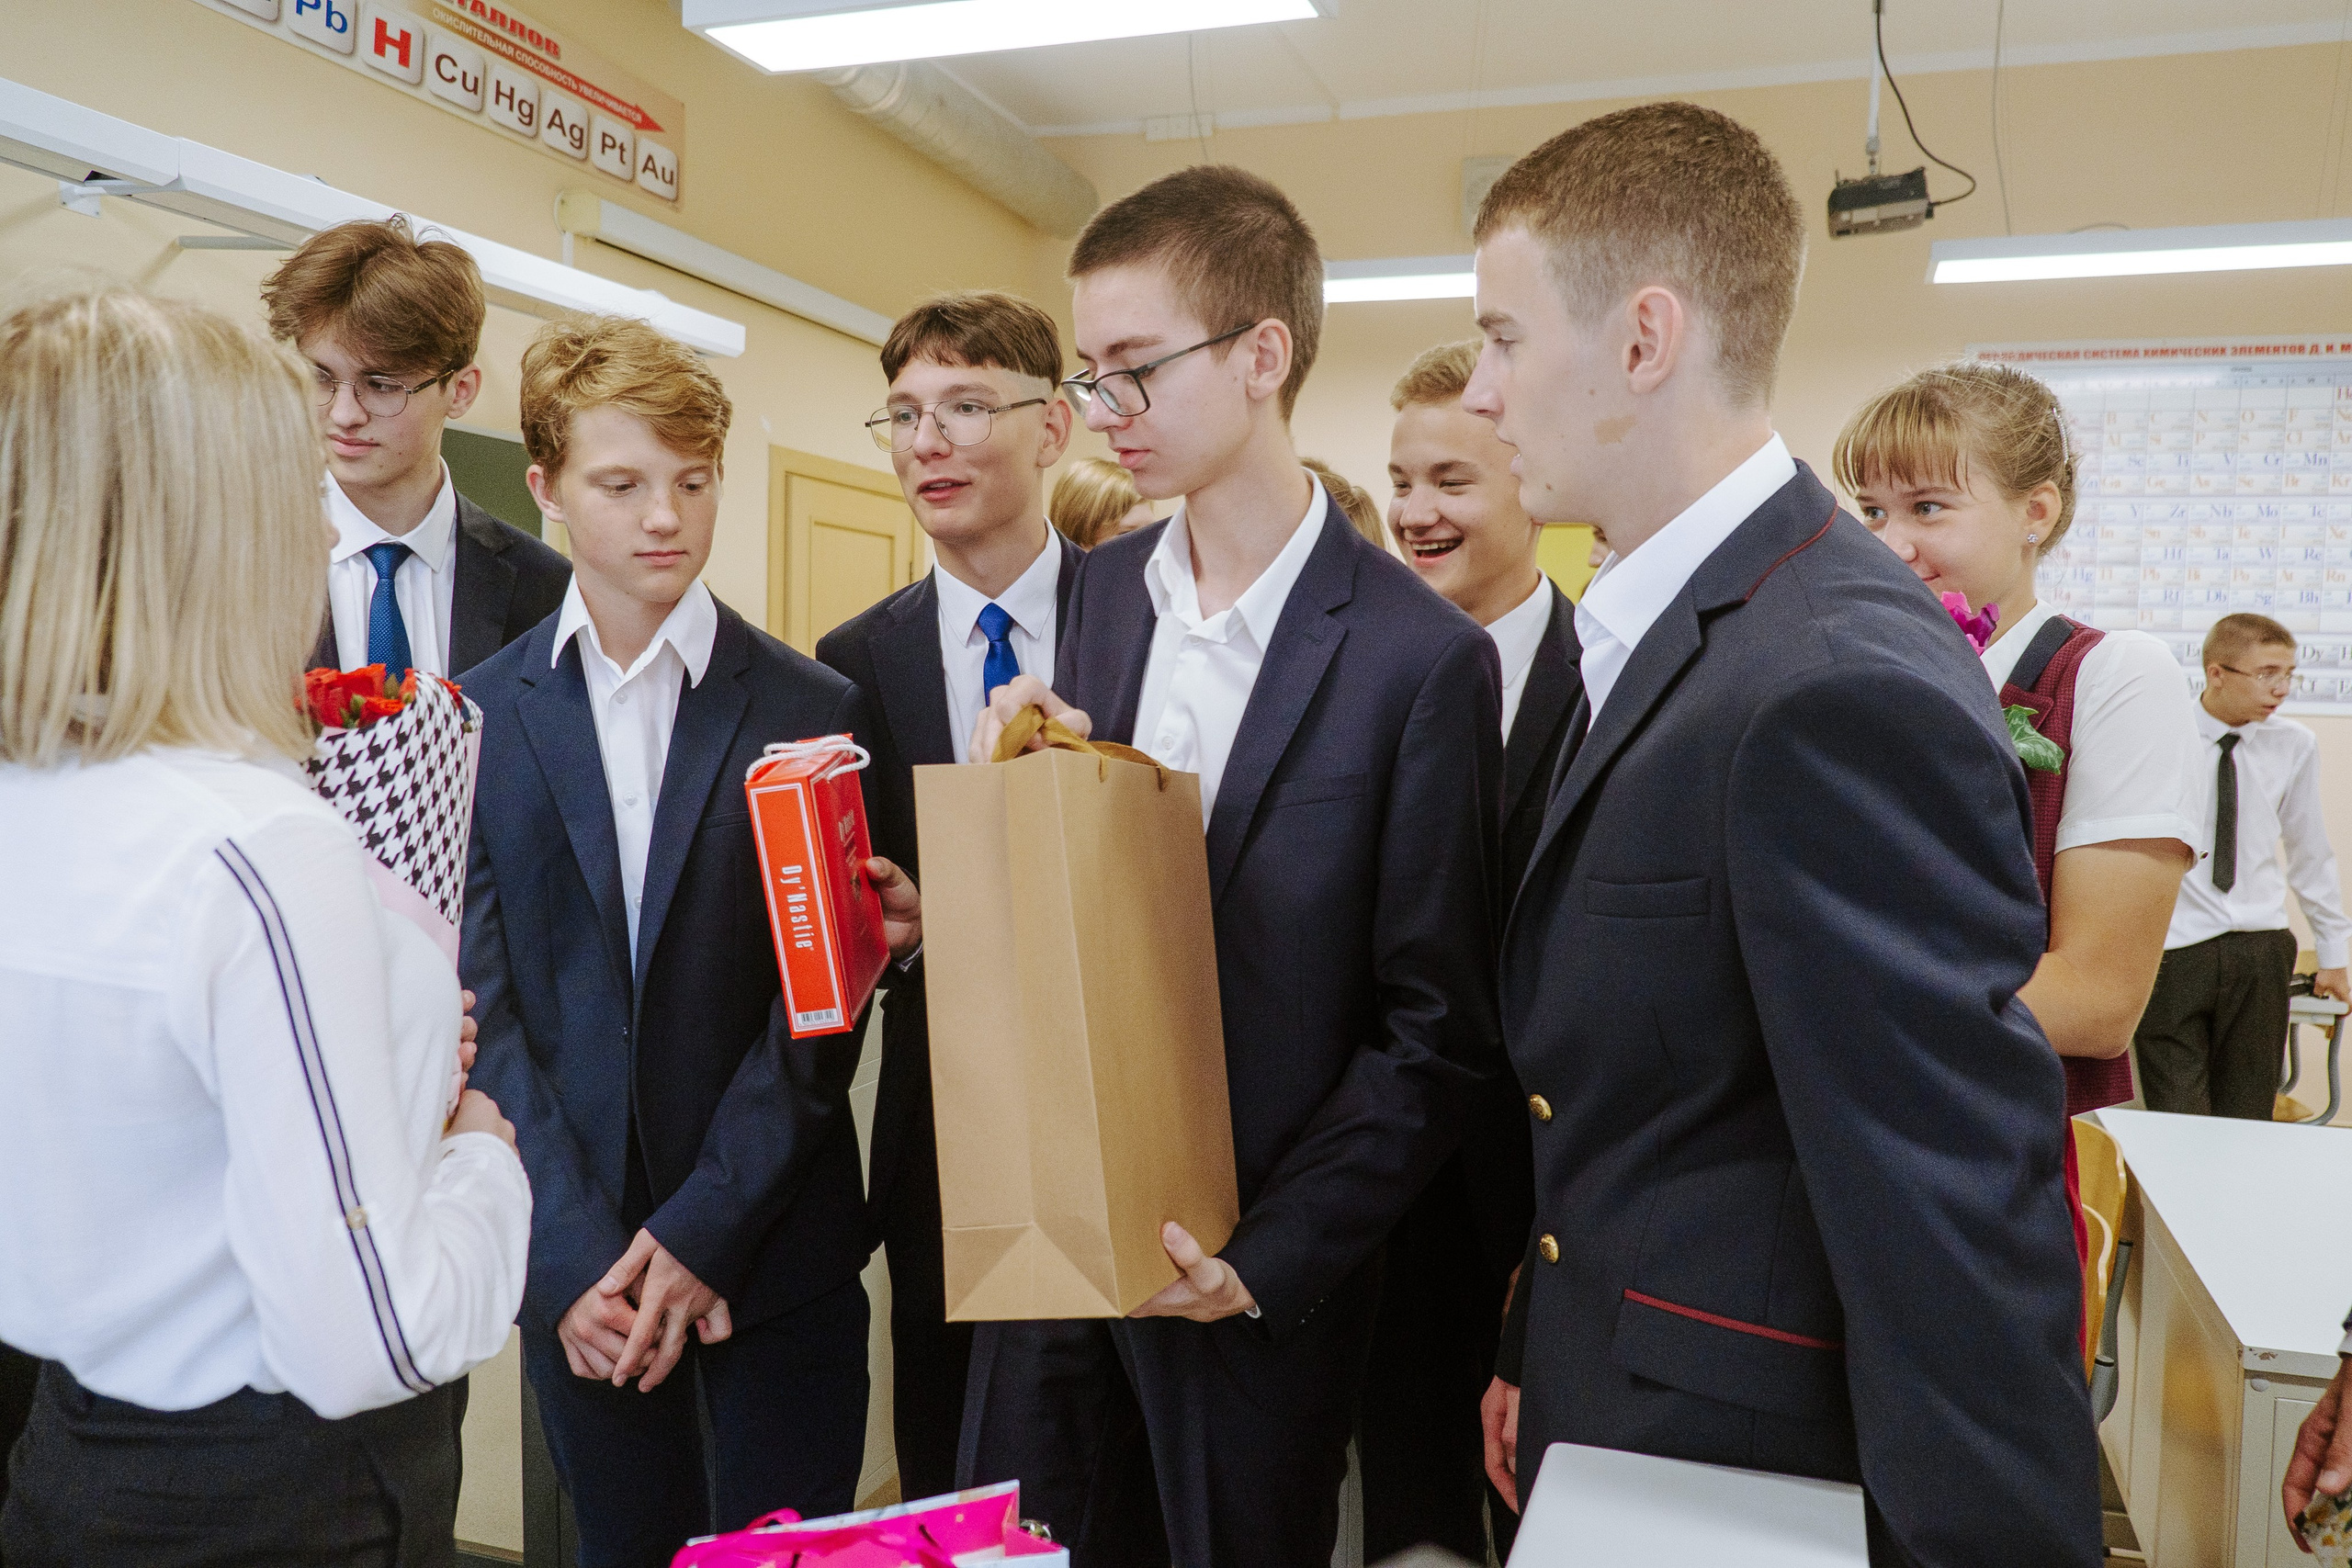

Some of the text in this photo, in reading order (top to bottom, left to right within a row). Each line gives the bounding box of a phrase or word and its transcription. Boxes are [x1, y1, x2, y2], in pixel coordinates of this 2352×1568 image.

[433, 8, 514, 56] ОКИСЛИТЕЛЬНАЯ
[514, 51, 579, 90] СПОСОБНОСТЬ
[445, 0, 560, 58] АЛЛОВ
[373, 17, 412, 69] H
[435, 53, 479, 96] Cu
[494, 79, 534, 127] Hg
[547, 108, 584, 151] Ag
[601, 131, 628, 165] Pt
[642, 153, 674, 186] Au
[2231, 344, 2305, 356] ЭЛЕМЕНТОВ
[2303, 453, 2327, 466] Mn
